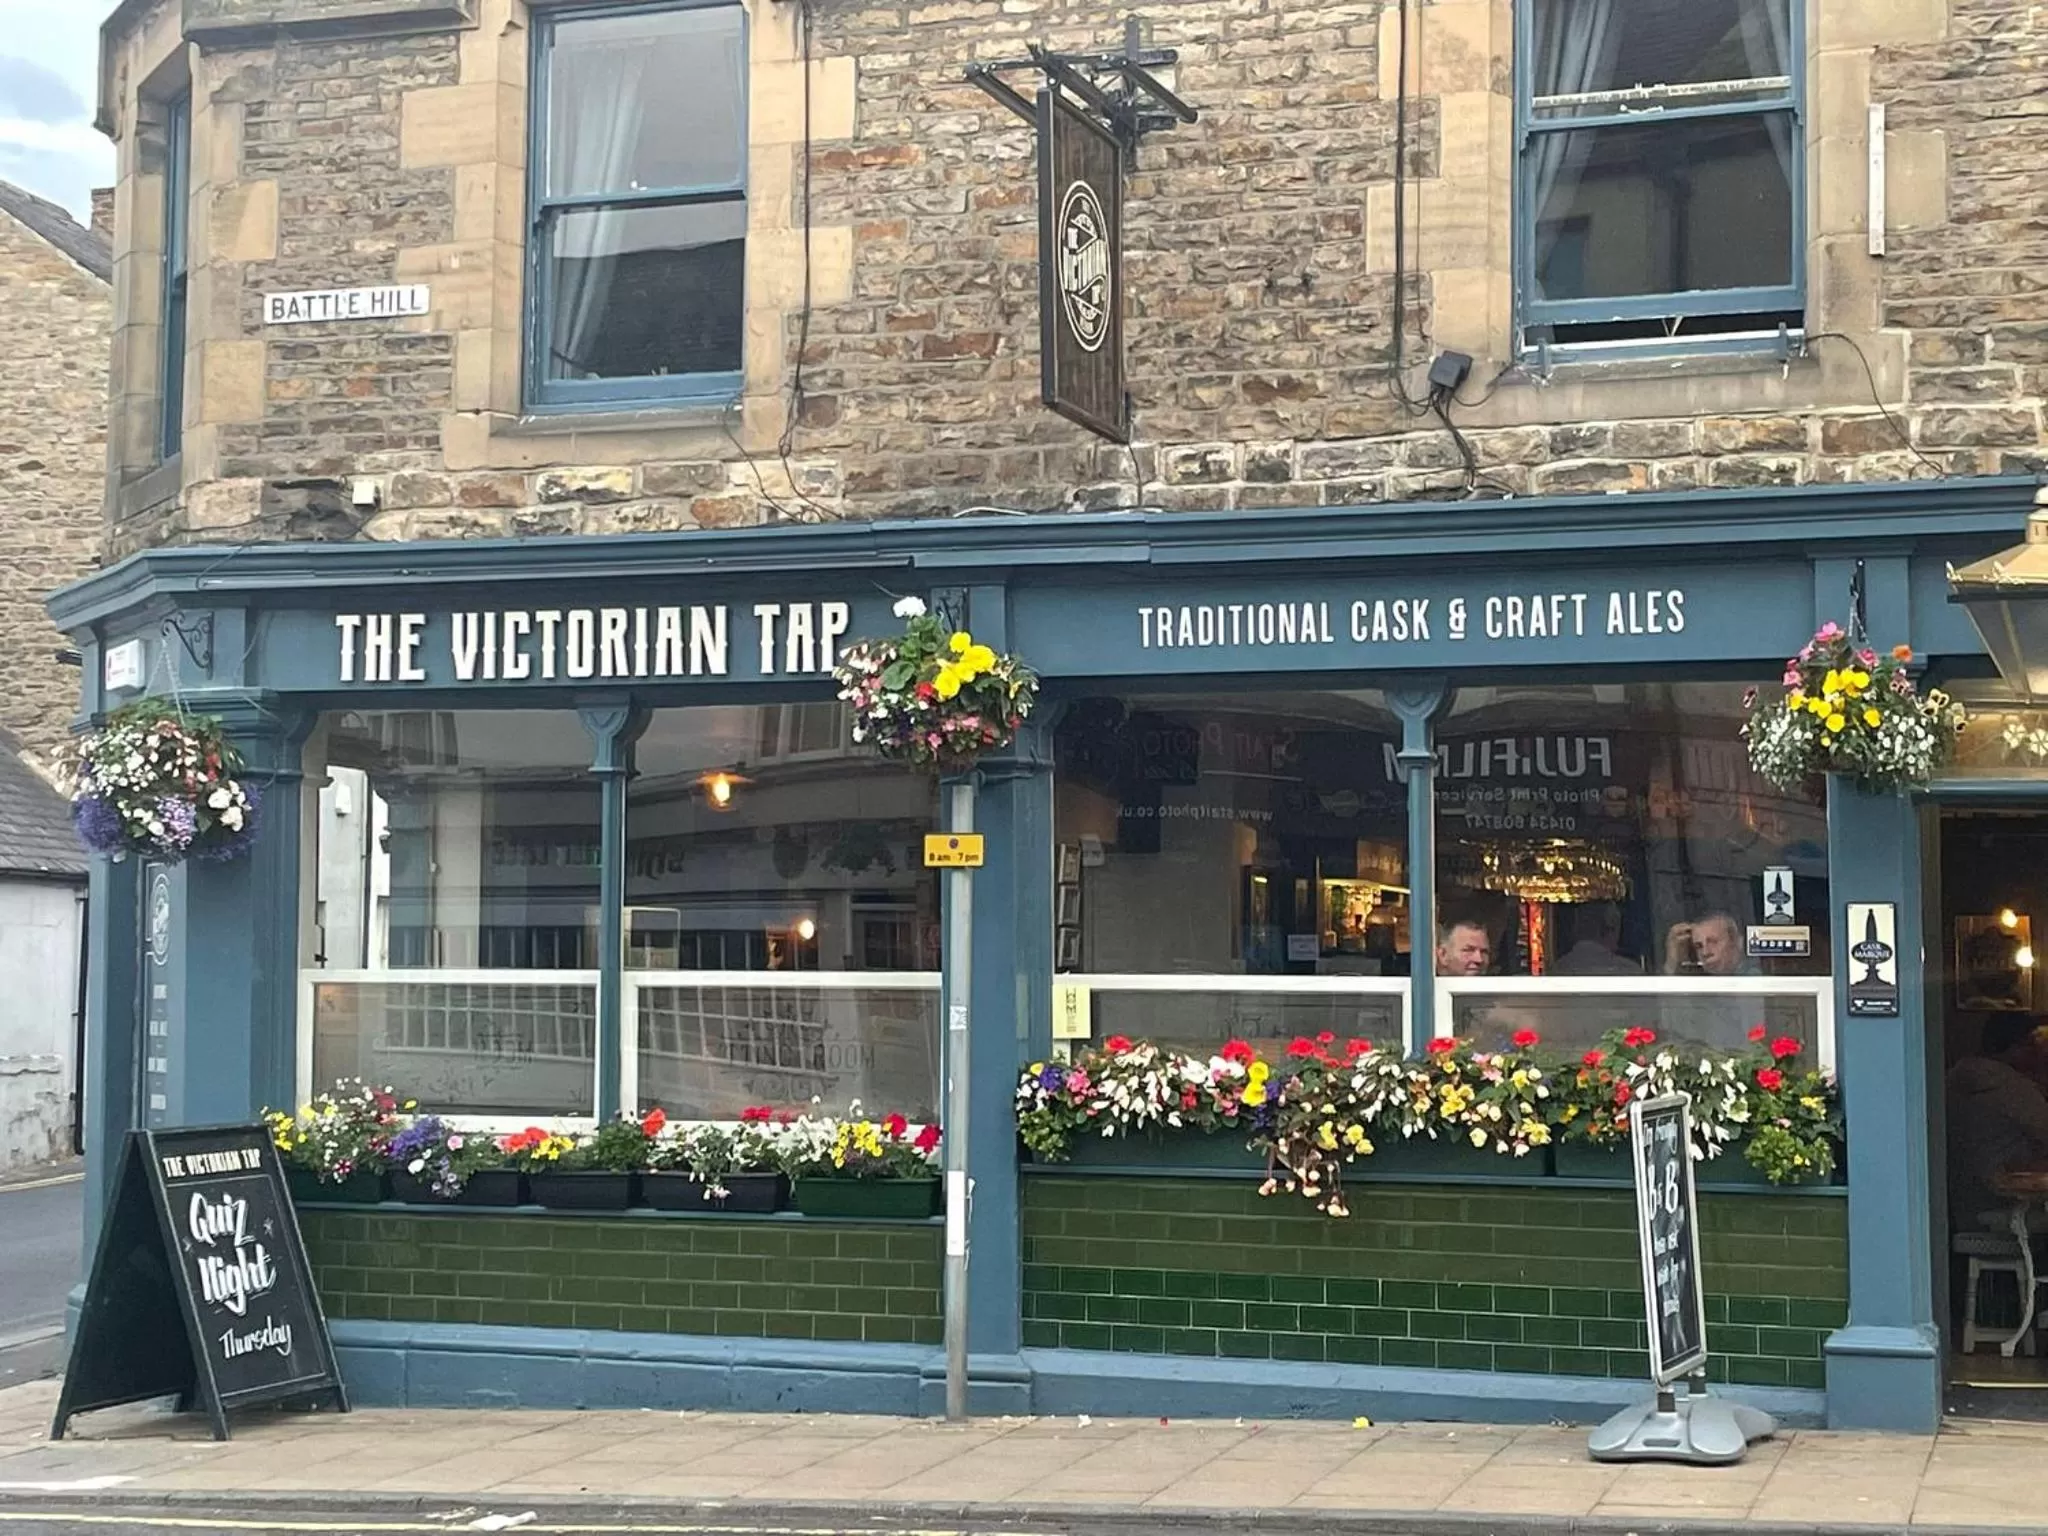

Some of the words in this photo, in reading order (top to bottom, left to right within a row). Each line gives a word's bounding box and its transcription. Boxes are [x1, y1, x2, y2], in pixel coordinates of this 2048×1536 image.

[272, 293, 360, 320] BATTLE
[371, 289, 422, 313] HILL
[335, 613, 426, 682] THE
[451, 605, 727, 680] VICTORIAN
[753, 602, 848, 674] TAP
[1138, 602, 1335, 648] TRADITIONAL
[1350, 598, 1431, 642] CASK
[1448, 598, 1467, 639] &
[1485, 594, 1588, 638] CRAFT
[1606, 590, 1685, 635] ALES
[162, 1156, 186, 1178] THE
[185, 1150, 242, 1176] VICTORIAN
[241, 1148, 261, 1169] TAP
[189, 1192, 257, 1248] Quiz
[198, 1243, 277, 1317] Night
[218, 1315, 293, 1359] Thursday
